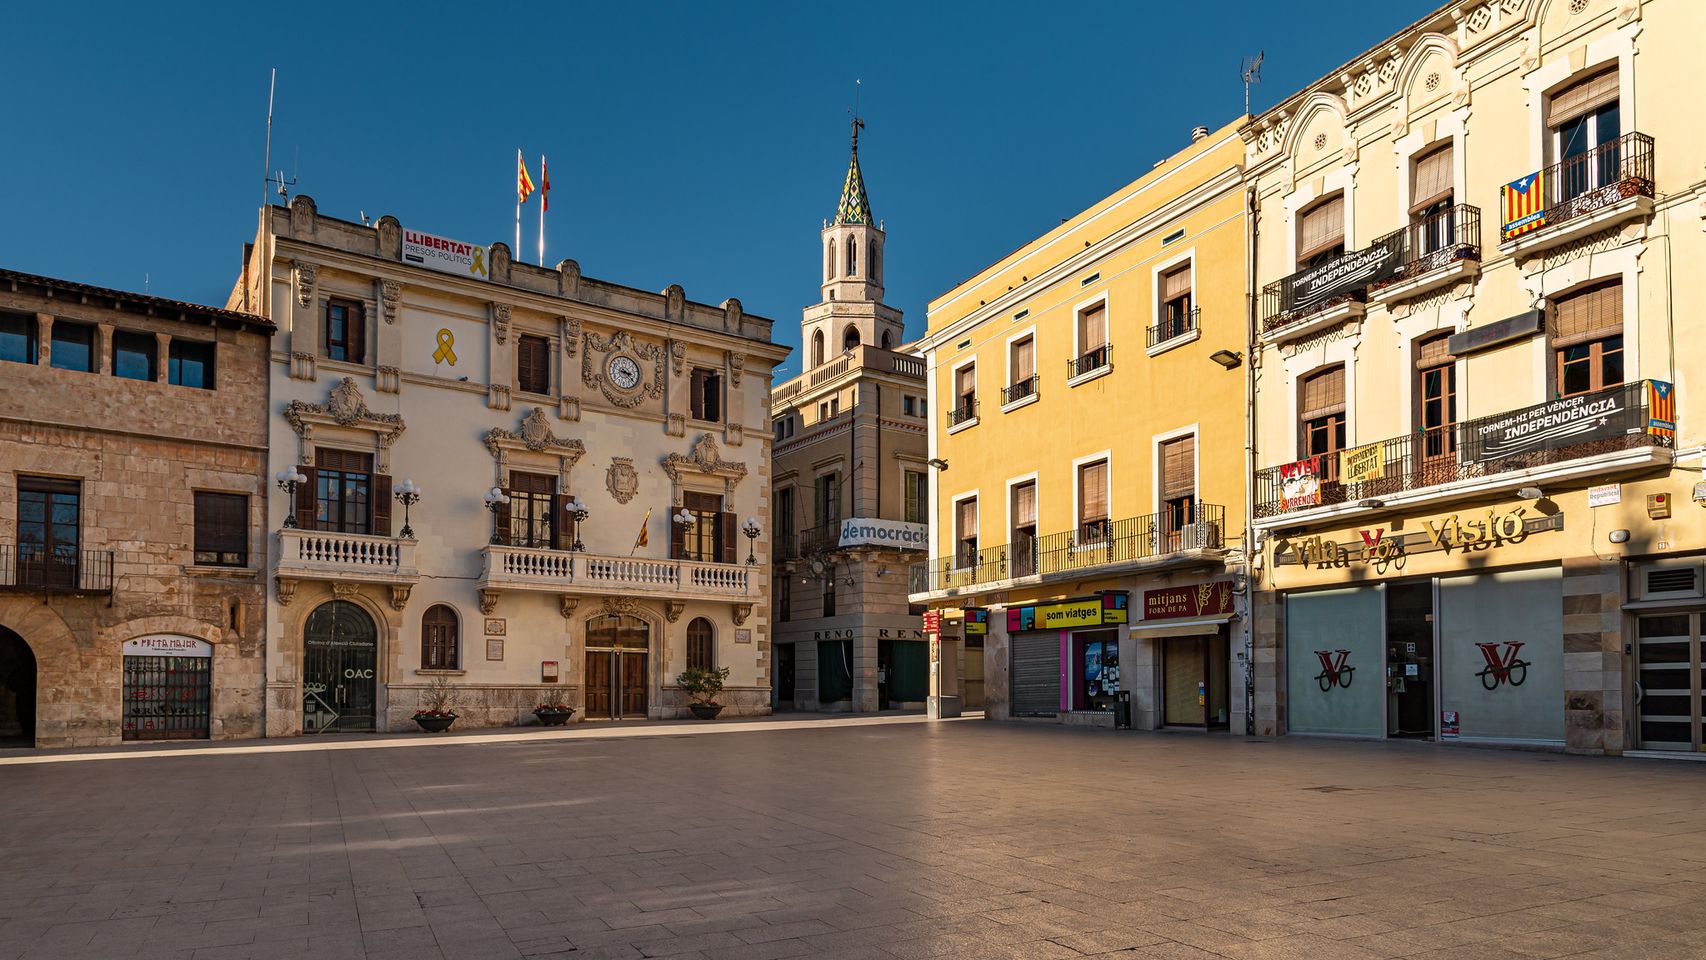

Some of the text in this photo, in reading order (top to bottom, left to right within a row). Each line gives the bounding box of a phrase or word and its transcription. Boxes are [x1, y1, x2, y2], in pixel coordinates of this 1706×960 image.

[1508, 213, 1541, 230] assemblea
[405, 231, 472, 256] LLIBERTAT
[405, 244, 436, 258] PRESOS
[438, 251, 472, 266] POLÍTICS
[1292, 265, 1328, 289] TORNEM-HI
[1327, 258, 1340, 271] PER
[1310, 245, 1388, 290] INDEPENDÈNCIA
[1478, 396, 1585, 436] TORNEM-HI PER VÈNCER
[1503, 397, 1617, 440] INDEPENDÈNCIA
[1281, 455, 1320, 479] NEVER
[1290, 535, 1340, 565] Vila
[1421, 506, 1527, 548] Visió
[1148, 593, 1187, 606] mitjans
[1148, 606, 1166, 614] FORN
[1167, 605, 1176, 613] DE
[1046, 610, 1064, 620] som
[1065, 607, 1097, 620] viatges
[814, 629, 853, 640] RENO
[879, 629, 923, 639] REN
[344, 668, 374, 679] OAC
